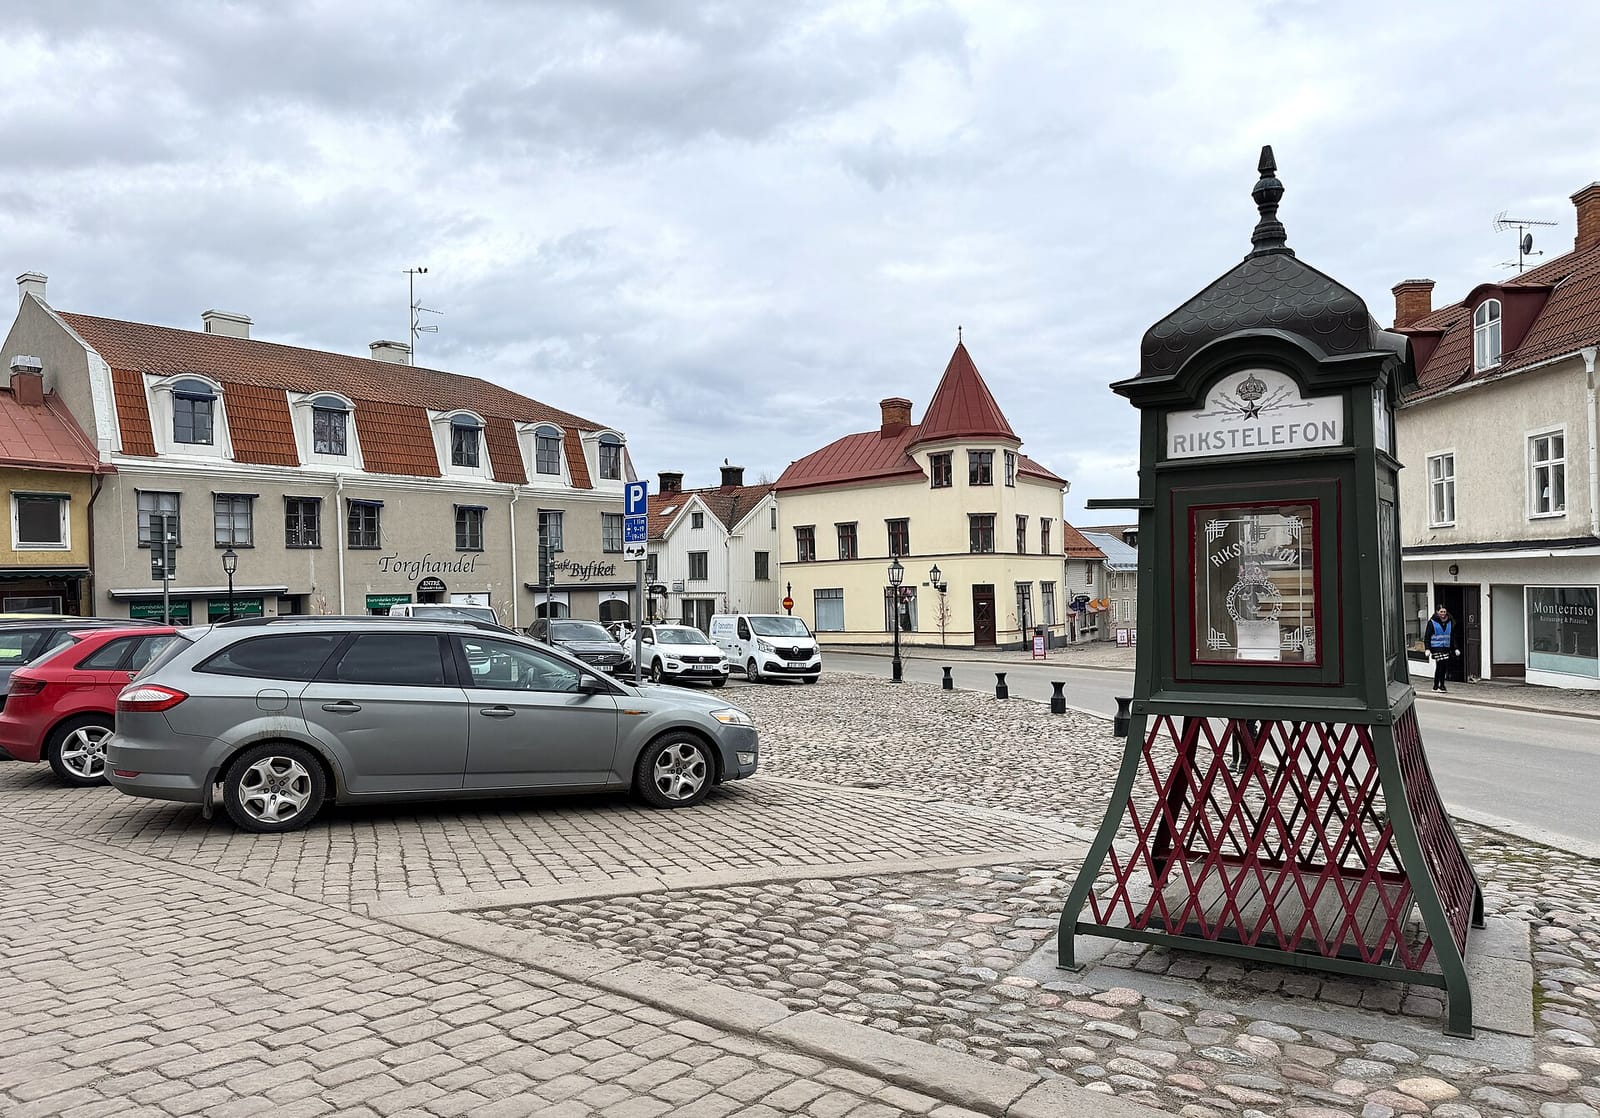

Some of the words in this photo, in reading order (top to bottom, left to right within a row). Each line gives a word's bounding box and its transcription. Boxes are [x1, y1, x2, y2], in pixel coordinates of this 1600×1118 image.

[1173, 420, 1336, 454] RIKSTELEFON
[630, 485, 644, 513] P
[378, 552, 480, 581] Torghandel
[568, 560, 617, 581] Byfiket
[1533, 601, 1594, 616] Montecristo
